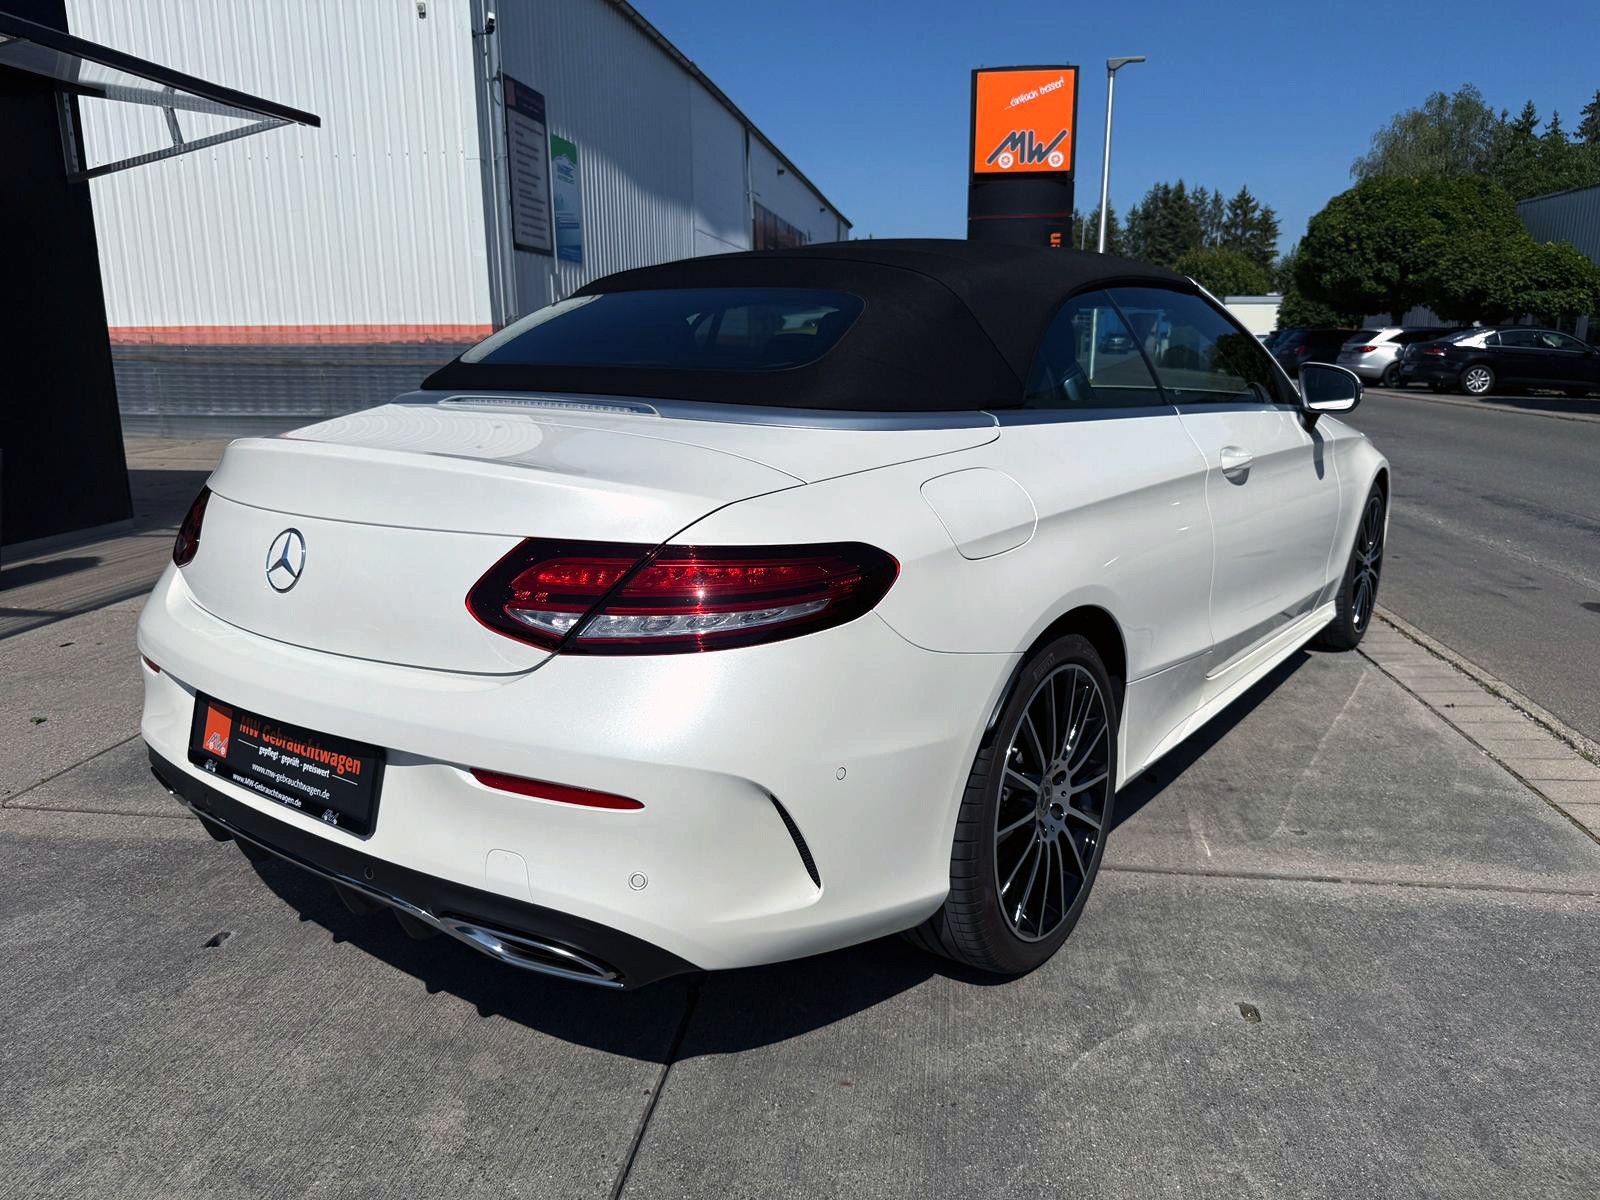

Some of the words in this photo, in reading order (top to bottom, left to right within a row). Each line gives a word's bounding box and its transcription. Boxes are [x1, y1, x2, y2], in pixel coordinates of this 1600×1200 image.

[986, 129, 1068, 165] MW
[240, 714, 260, 738] MW
[262, 723, 361, 775] Gebrauchtwagen
[259, 746, 279, 761] gepflegt
[281, 755, 300, 768] geprüft
[303, 763, 330, 778] preiswert
[232, 773, 302, 808] www.MW-Gebrauchtwagen.de
[251, 763, 331, 800] www.mw-gebrauchtwagen.de
